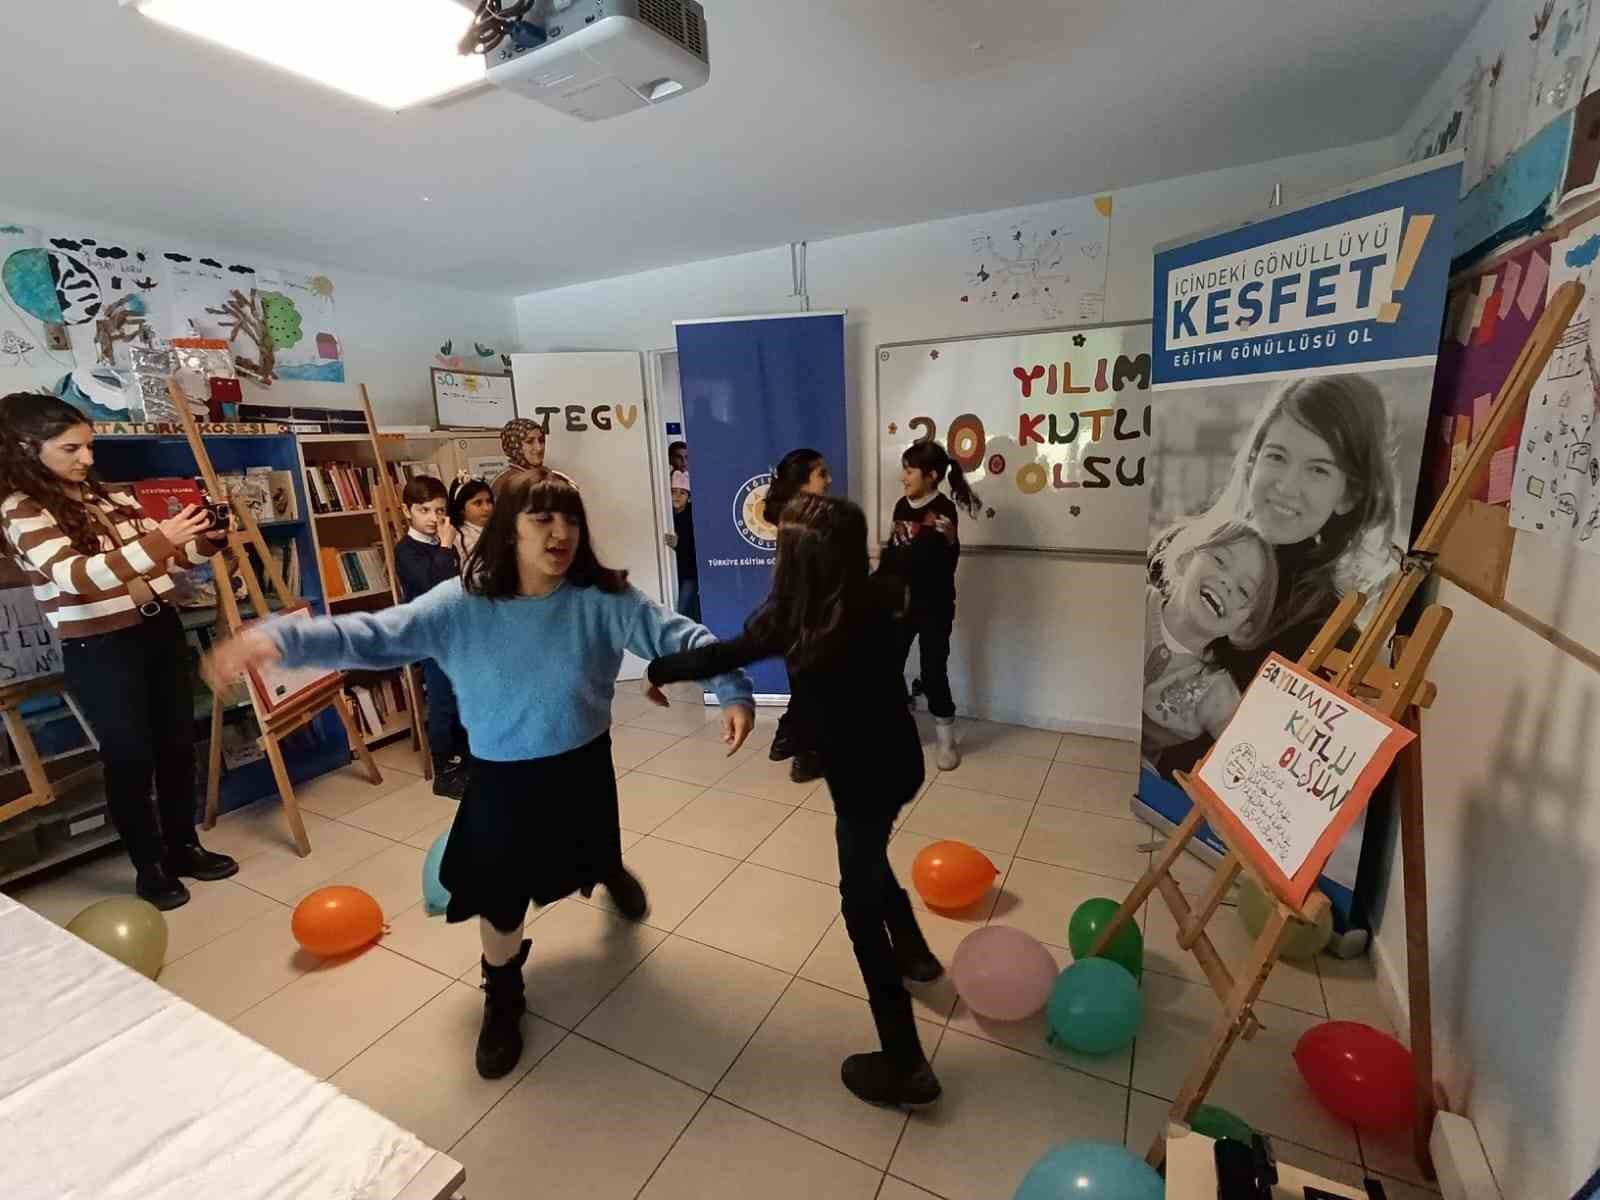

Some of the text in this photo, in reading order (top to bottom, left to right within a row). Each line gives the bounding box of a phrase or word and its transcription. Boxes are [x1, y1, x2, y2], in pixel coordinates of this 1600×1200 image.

[1174, 222, 1389, 297] İÇİNDEKİ GÖNÜLLÜYÜ
[1173, 327, 1374, 368] EĞİTİM GÖNÜLLÜSÜ OL
[534, 404, 638, 435] TEGV
[1019, 404, 1151, 446] KUTL
[1283, 709, 1357, 776] KUTLU
